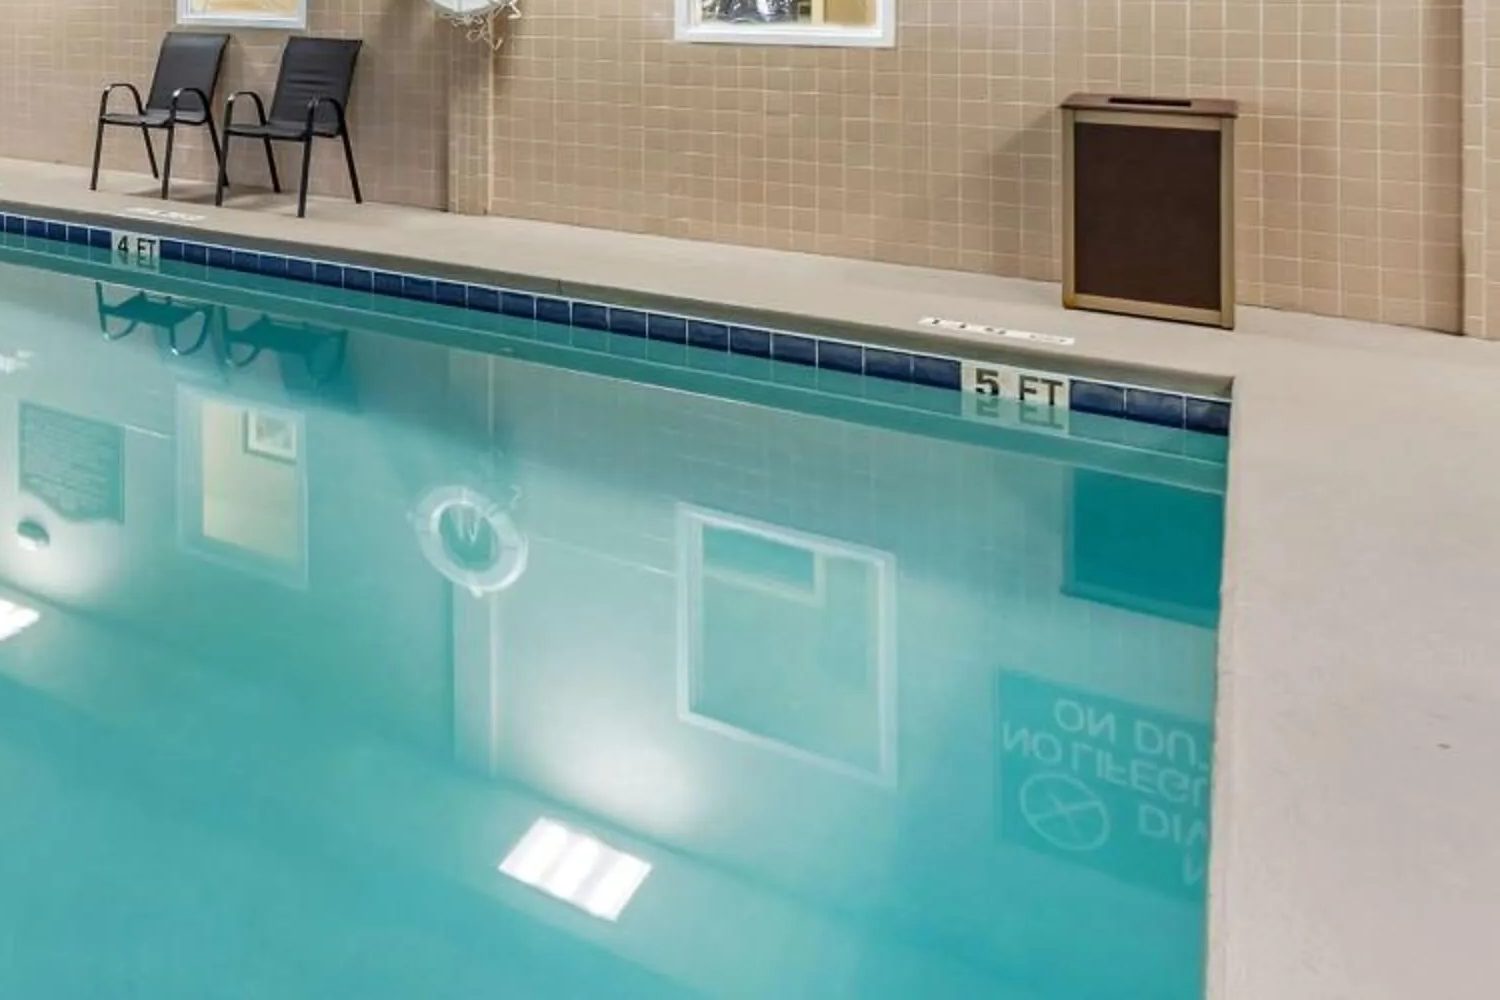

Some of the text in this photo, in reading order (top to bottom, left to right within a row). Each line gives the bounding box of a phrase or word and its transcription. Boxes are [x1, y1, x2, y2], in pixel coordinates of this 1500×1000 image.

[117, 235, 157, 256] 4 FT
[975, 367, 1063, 406] 5 FT
